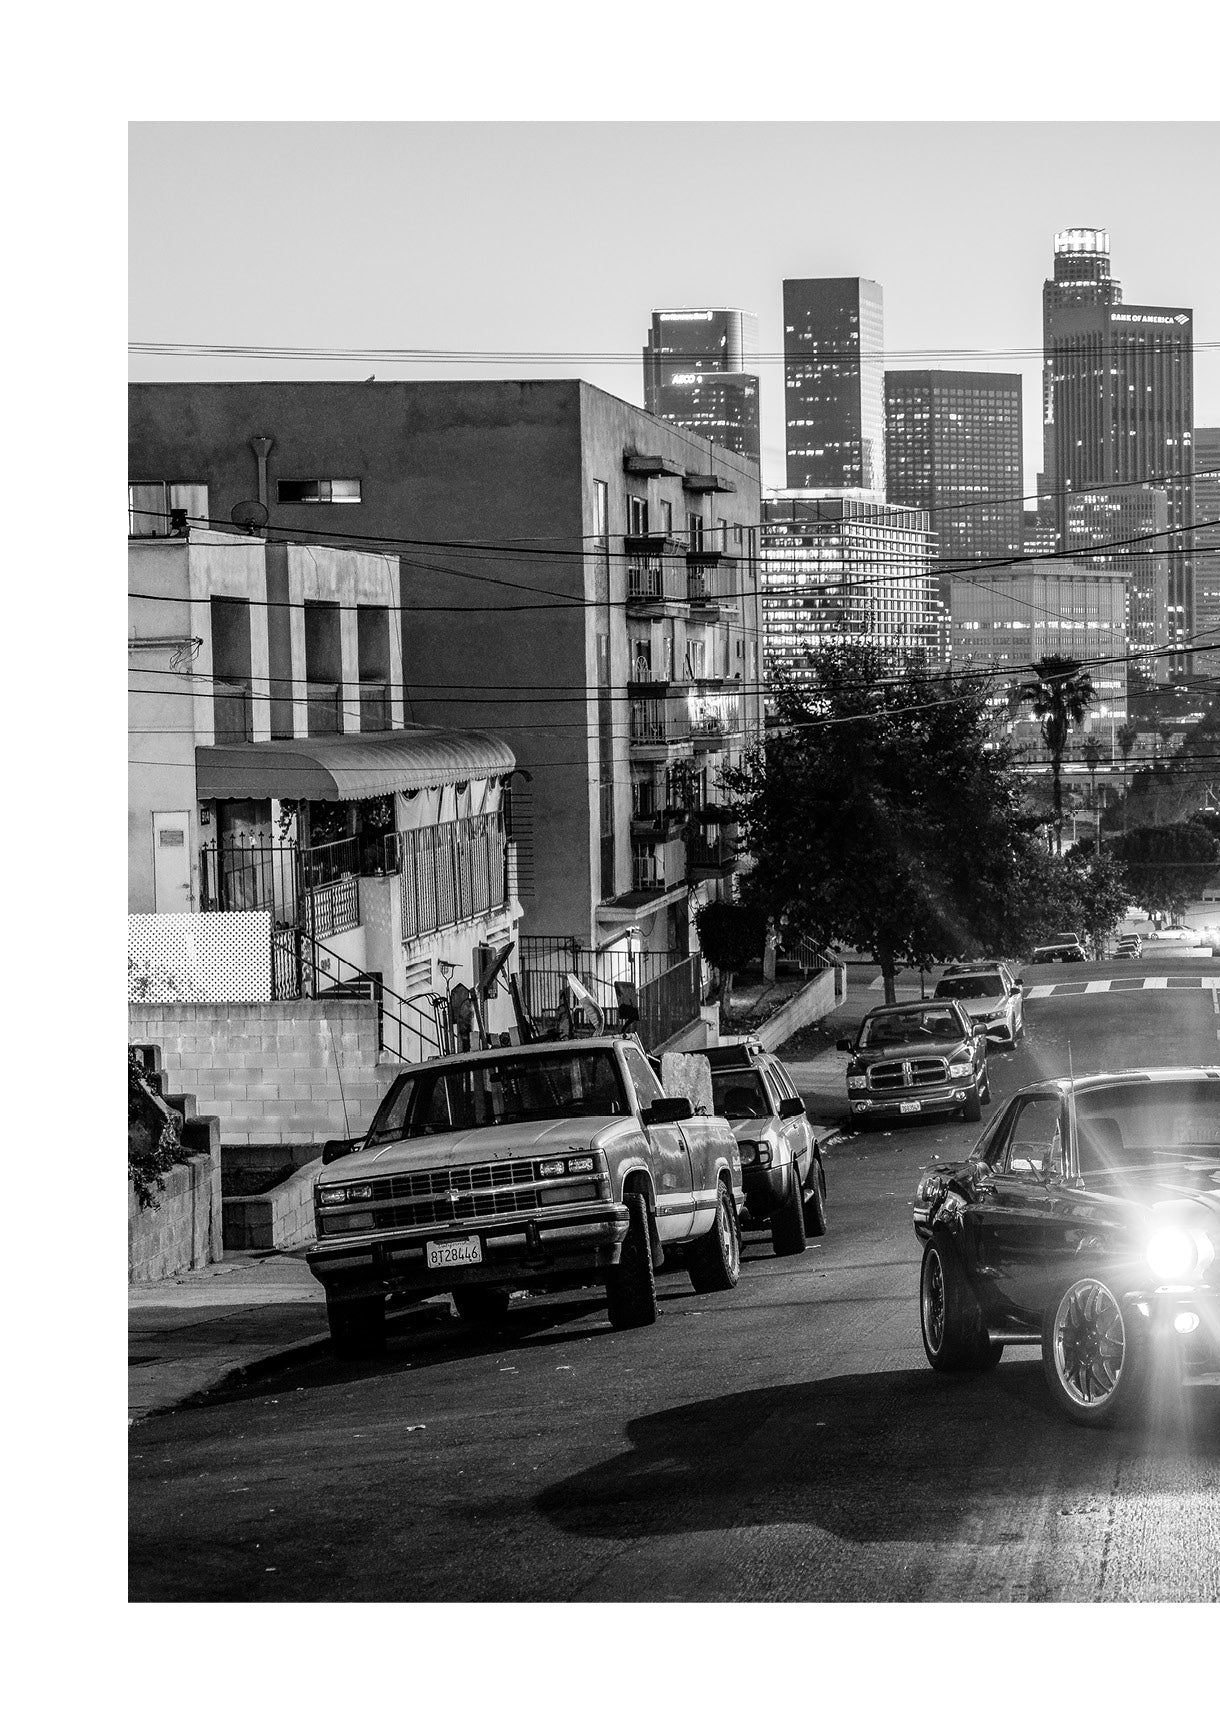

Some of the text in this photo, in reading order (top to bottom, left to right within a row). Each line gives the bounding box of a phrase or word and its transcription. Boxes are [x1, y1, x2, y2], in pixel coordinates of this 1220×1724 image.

[1111, 313, 1131, 321] BANK
[1142, 315, 1174, 324] AMERICA
[431, 1246, 478, 1263] 8T28446
